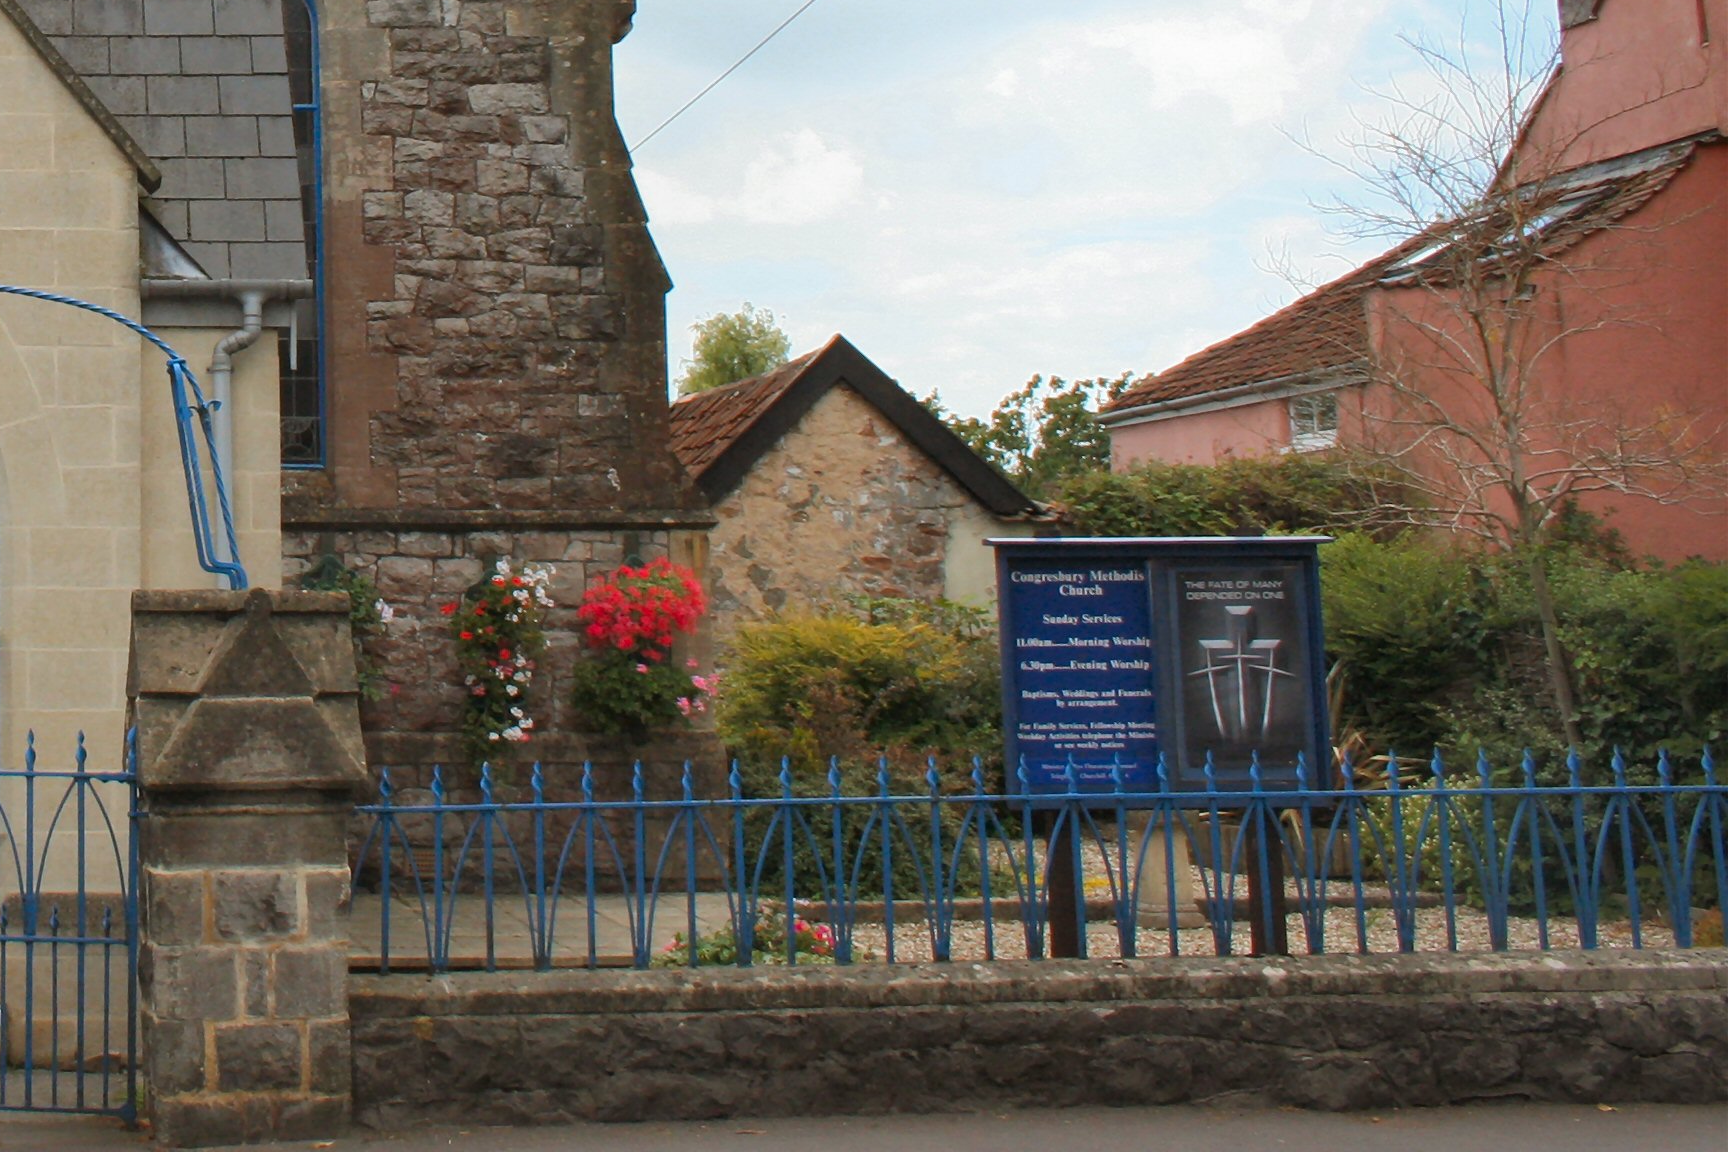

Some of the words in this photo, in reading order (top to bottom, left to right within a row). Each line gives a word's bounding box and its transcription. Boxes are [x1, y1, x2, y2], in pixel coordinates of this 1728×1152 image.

[1011, 570, 1084, 584] Congresbury
[1089, 569, 1145, 582] Methodis
[1185, 580, 1205, 589] THE
[1207, 580, 1233, 589] FATE
[1235, 580, 1250, 589] OF
[1252, 580, 1283, 589] MANY
[1059, 584, 1103, 596] Church
[1186, 591, 1243, 600] DEPENDED
[1244, 591, 1261, 600] ON
[1262, 591, 1285, 600] ONE
[1042, 613, 1078, 626] Sunday
[1081, 613, 1123, 624] Services
[1110, 659, 1150, 671] Worship
[1101, 689, 1115, 697] and
[1128, 731, 1155, 740] Ministe
